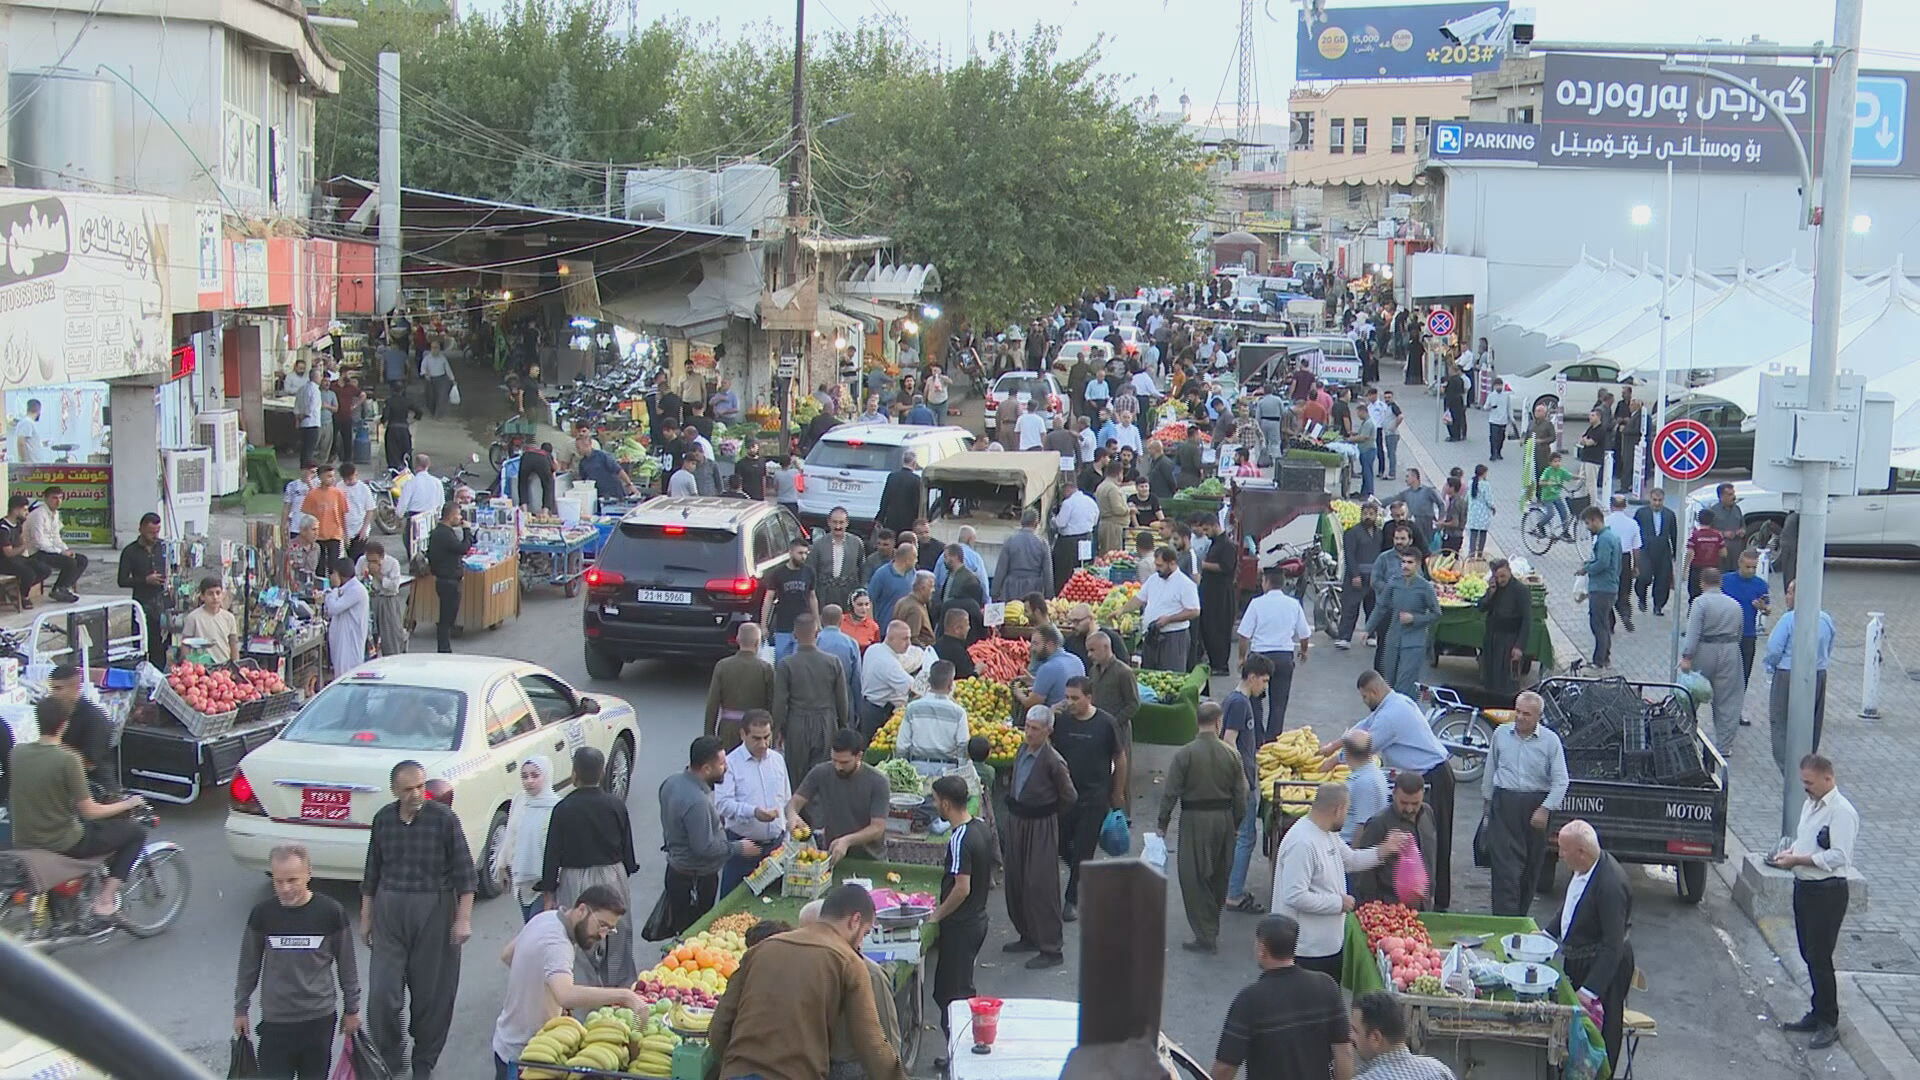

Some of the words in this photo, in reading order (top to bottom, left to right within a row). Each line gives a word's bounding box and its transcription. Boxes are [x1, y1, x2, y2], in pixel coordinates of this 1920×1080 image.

[1351, 35, 1380, 45] 15,000
[1464, 132, 1535, 150] PARKING
[15, 285, 32, 309] 868
[33, 279, 56, 304] 6032
[1321, 364, 1352, 374] ISSAN
[1561, 796, 1604, 812] HINING
[1665, 803, 1712, 821] MOTOR
